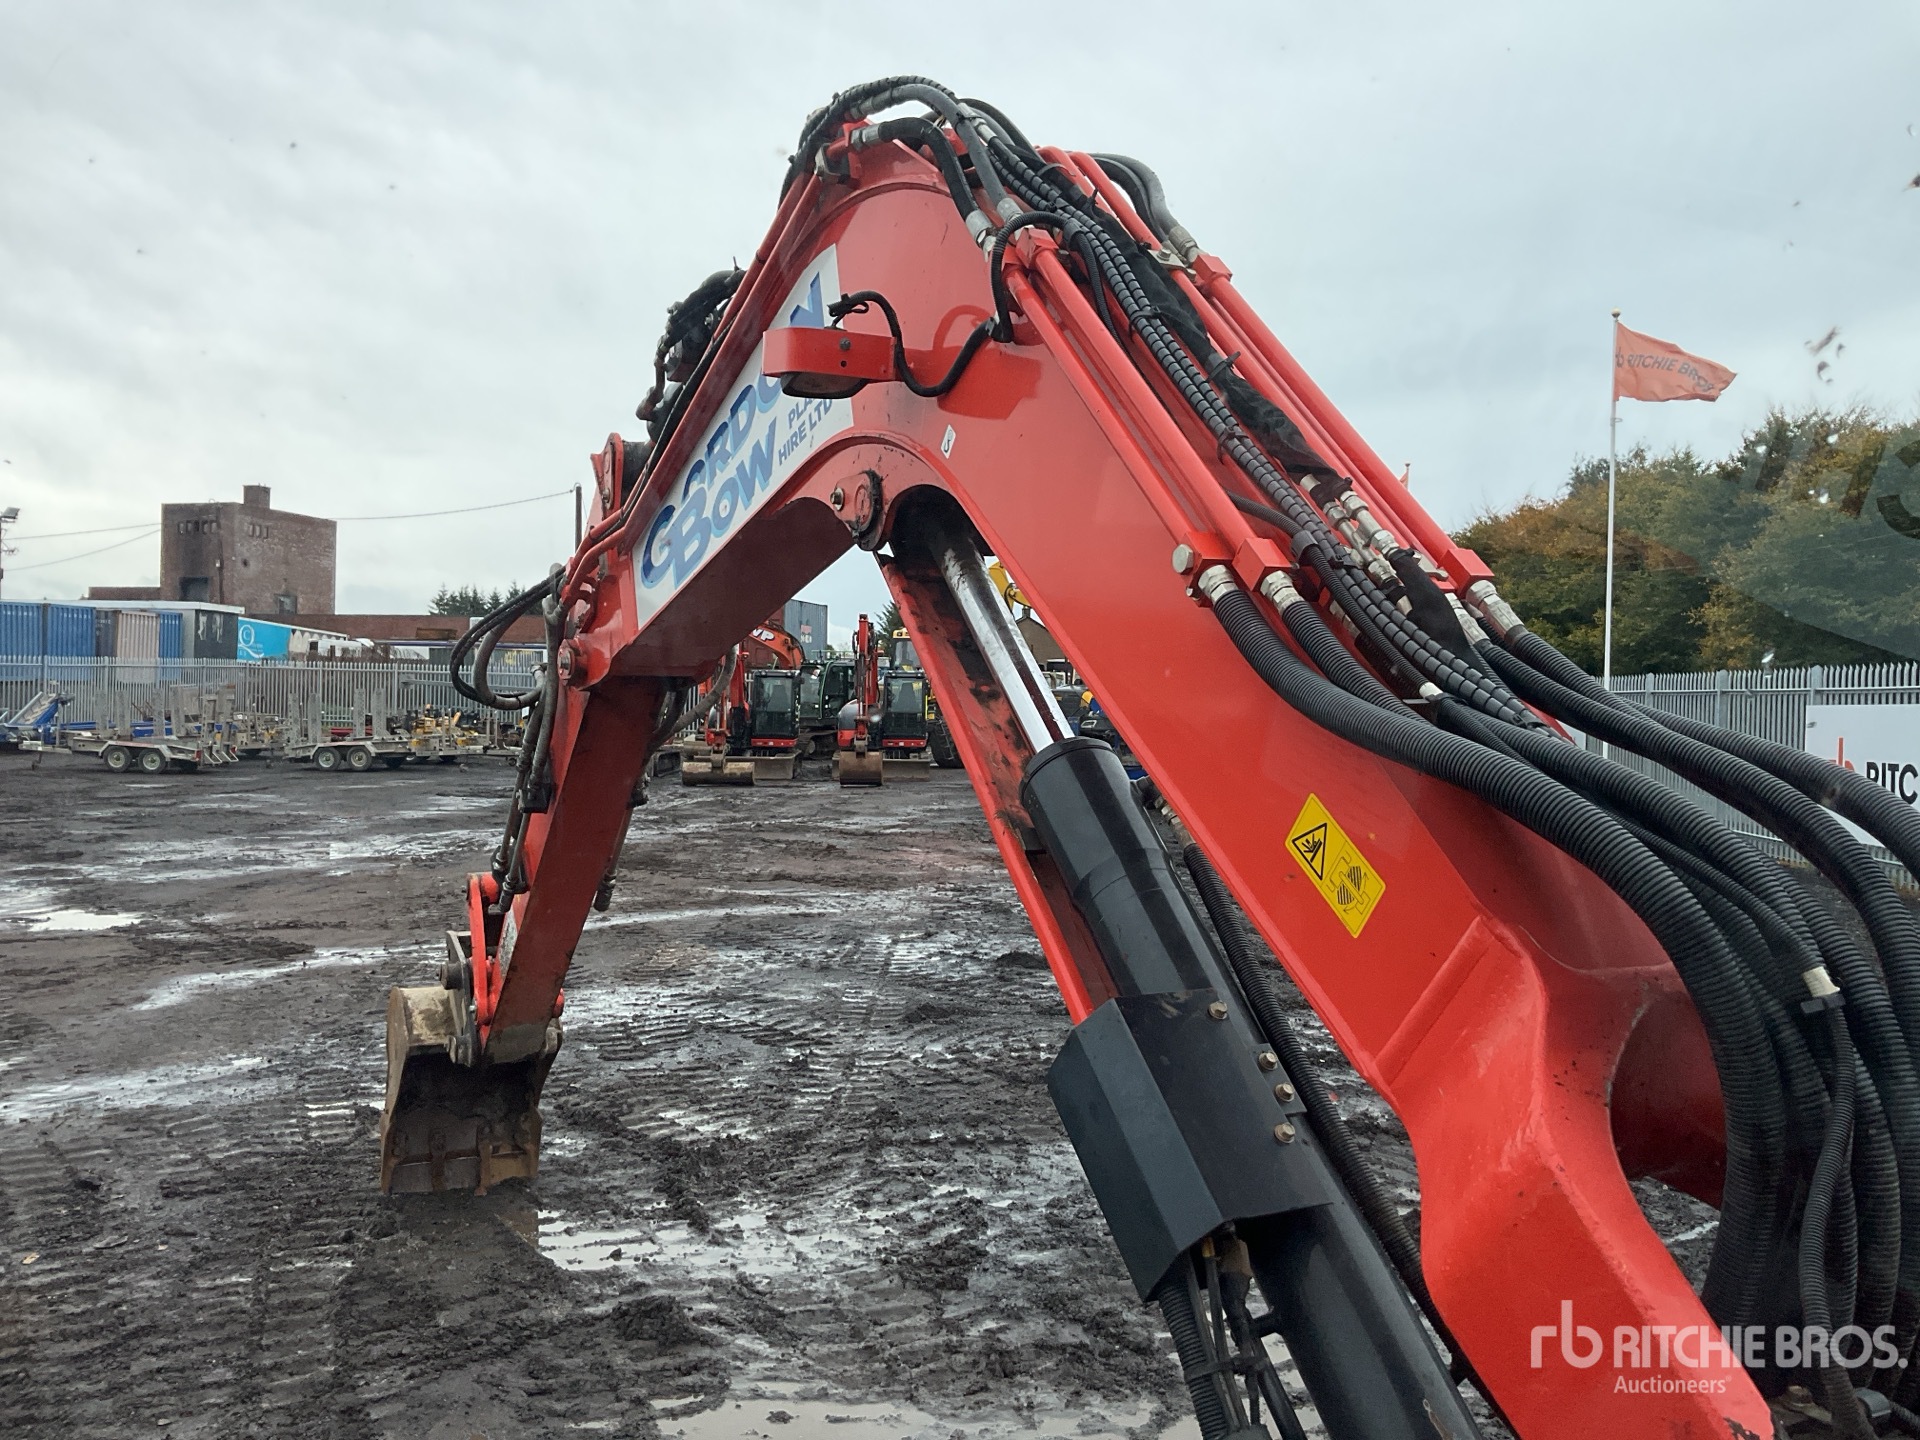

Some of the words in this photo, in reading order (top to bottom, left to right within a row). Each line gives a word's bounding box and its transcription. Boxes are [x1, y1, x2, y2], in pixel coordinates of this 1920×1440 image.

[1627, 353, 1678, 371] RITCHIE
[778, 420, 807, 466] HIRE
[808, 398, 833, 432] LTD
[787, 397, 815, 430] PLA
[672, 416, 777, 590] BOW
